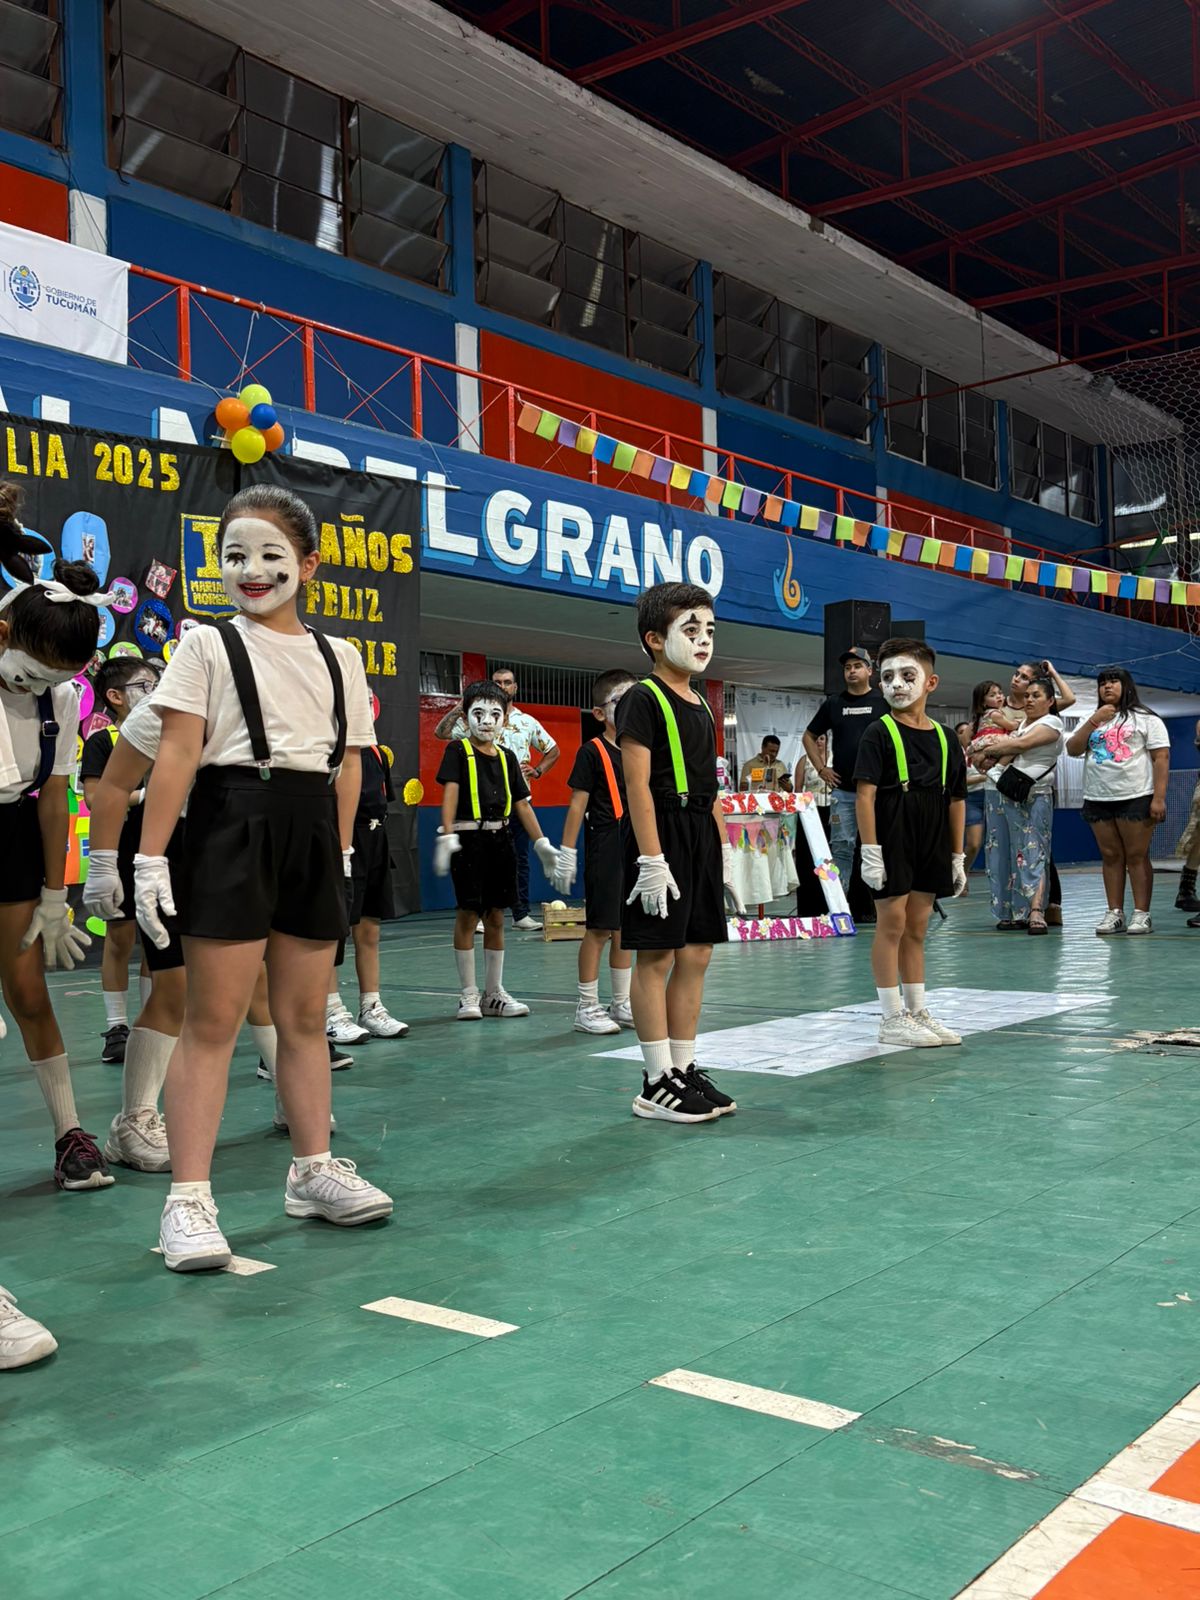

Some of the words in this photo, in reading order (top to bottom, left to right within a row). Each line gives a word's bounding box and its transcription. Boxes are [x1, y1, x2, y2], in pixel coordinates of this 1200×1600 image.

[45, 286, 85, 303] GOBIERNO
[87, 299, 96, 307] DE
[45, 294, 97, 317] TUCUMÁN
[6, 427, 69, 479] LIA
[94, 442, 181, 491] 2025
[293, 440, 725, 599] LGRANO
[320, 512, 413, 574] AÑOS
[305, 578, 383, 623] FELIZ
[768, 791, 797, 813] DE
[736, 916, 837, 942] FAMILIA
